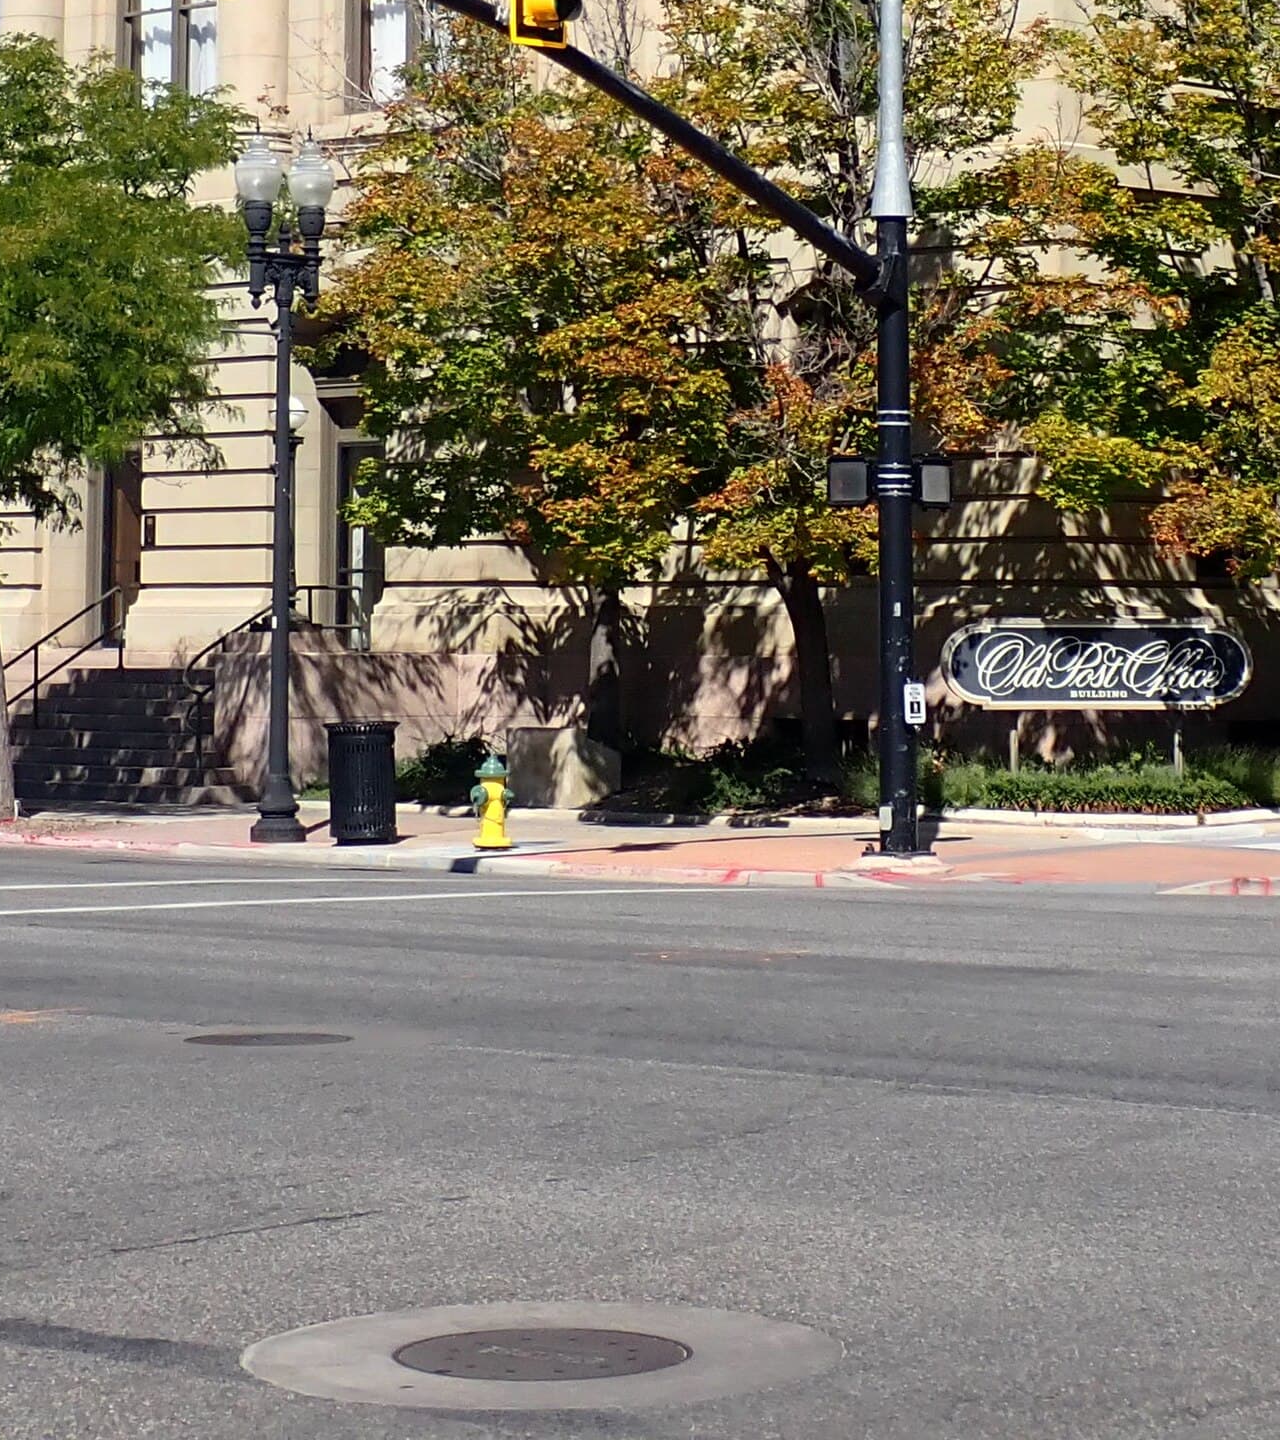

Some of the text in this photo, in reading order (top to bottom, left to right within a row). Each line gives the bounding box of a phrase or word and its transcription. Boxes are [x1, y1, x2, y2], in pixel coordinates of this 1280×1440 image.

[976, 632, 1225, 698] Old Post Office
[1070, 689, 1128, 698] BUILDING
